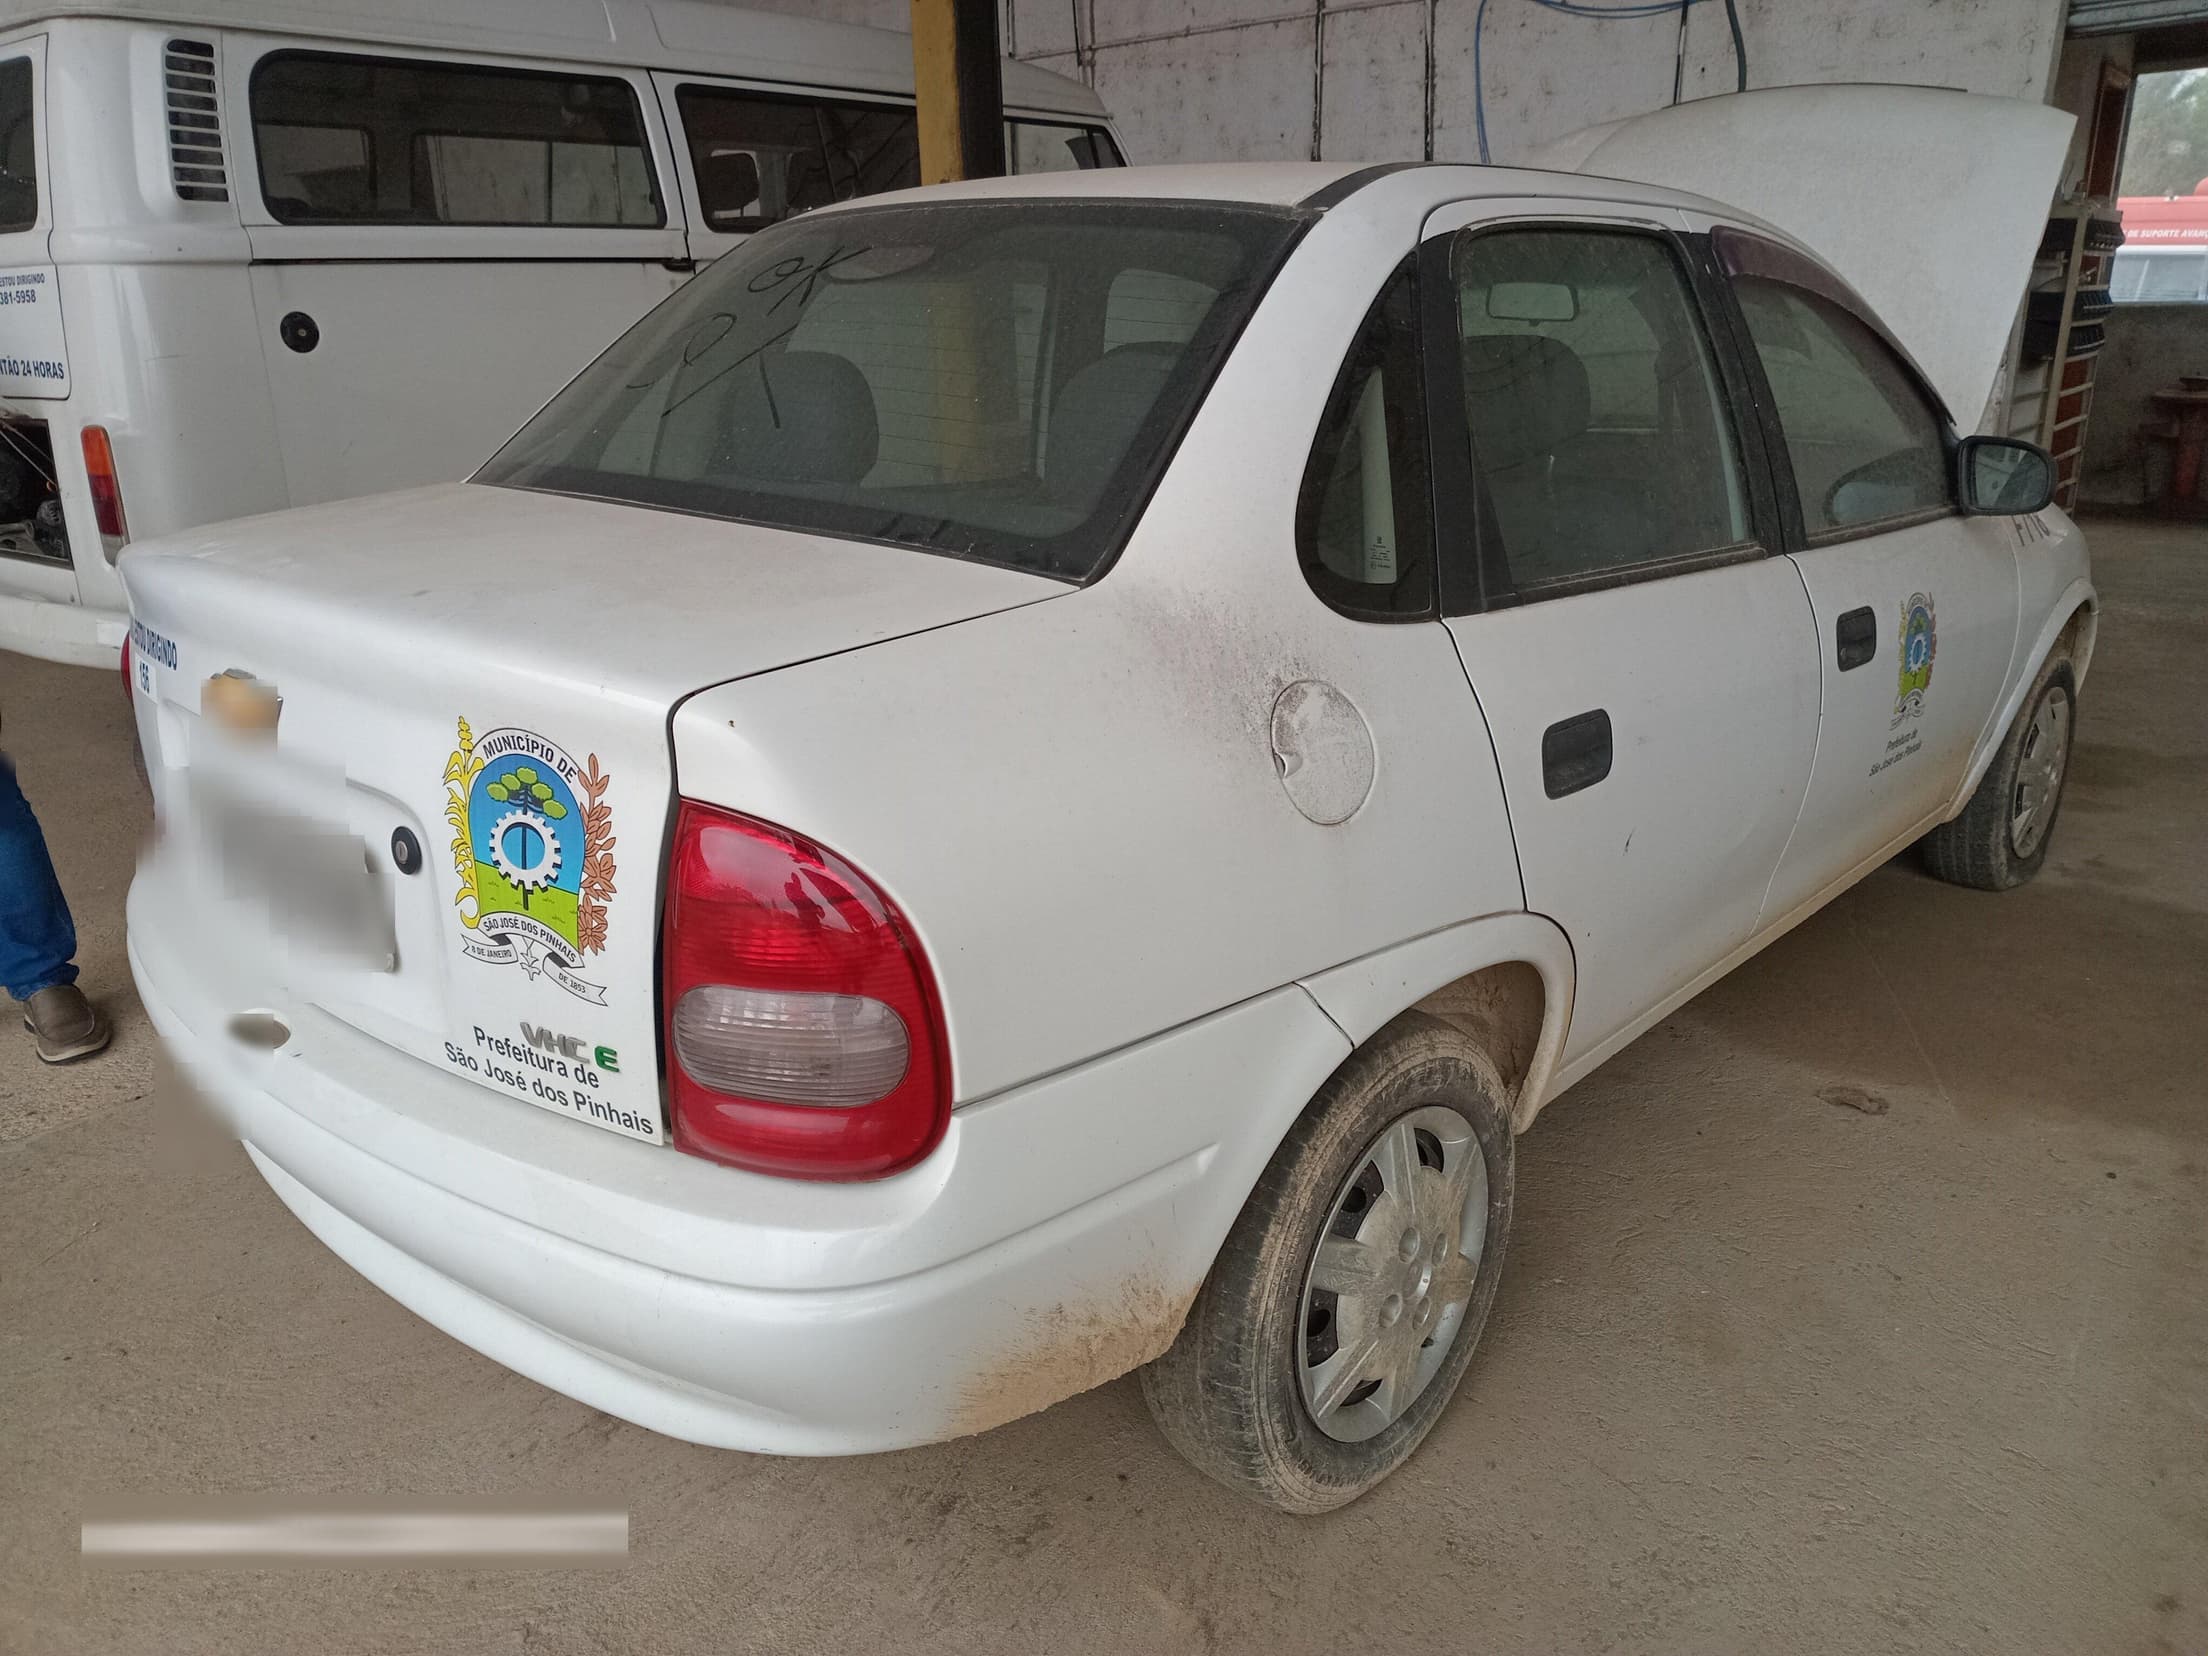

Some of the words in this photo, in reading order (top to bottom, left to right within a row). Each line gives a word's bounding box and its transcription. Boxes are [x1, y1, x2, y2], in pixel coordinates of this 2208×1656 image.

[2140, 229, 2179, 238] SUPORTE
[17, 273, 45, 286] DIRIGINDO
[21, 360, 32, 377] 24
[32, 360, 65, 379] HORAS
[147, 628, 178, 671] DIRIGINDO
[483, 734, 554, 763] MUNICÍPIO
[557, 757, 577, 784] DE
[476, 947, 486, 956] DE
[487, 949, 512, 958] JANEIRO
[484, 917, 498, 932] SÃO
[499, 916, 520, 931] JOSÉ
[520, 920, 539, 937] DOS
[540, 930, 576, 963] PINHAIS
[558, 972, 568, 984] DE
[570, 980, 586, 994] 1853
[473, 1025, 568, 1077] Prefeitura
[574, 1064, 599, 1088] de
[445, 1041, 478, 1072] São
[484, 1058, 527, 1091] José
[533, 1078, 569, 1107] dos
[573, 1091, 654, 1135] Pinhais
